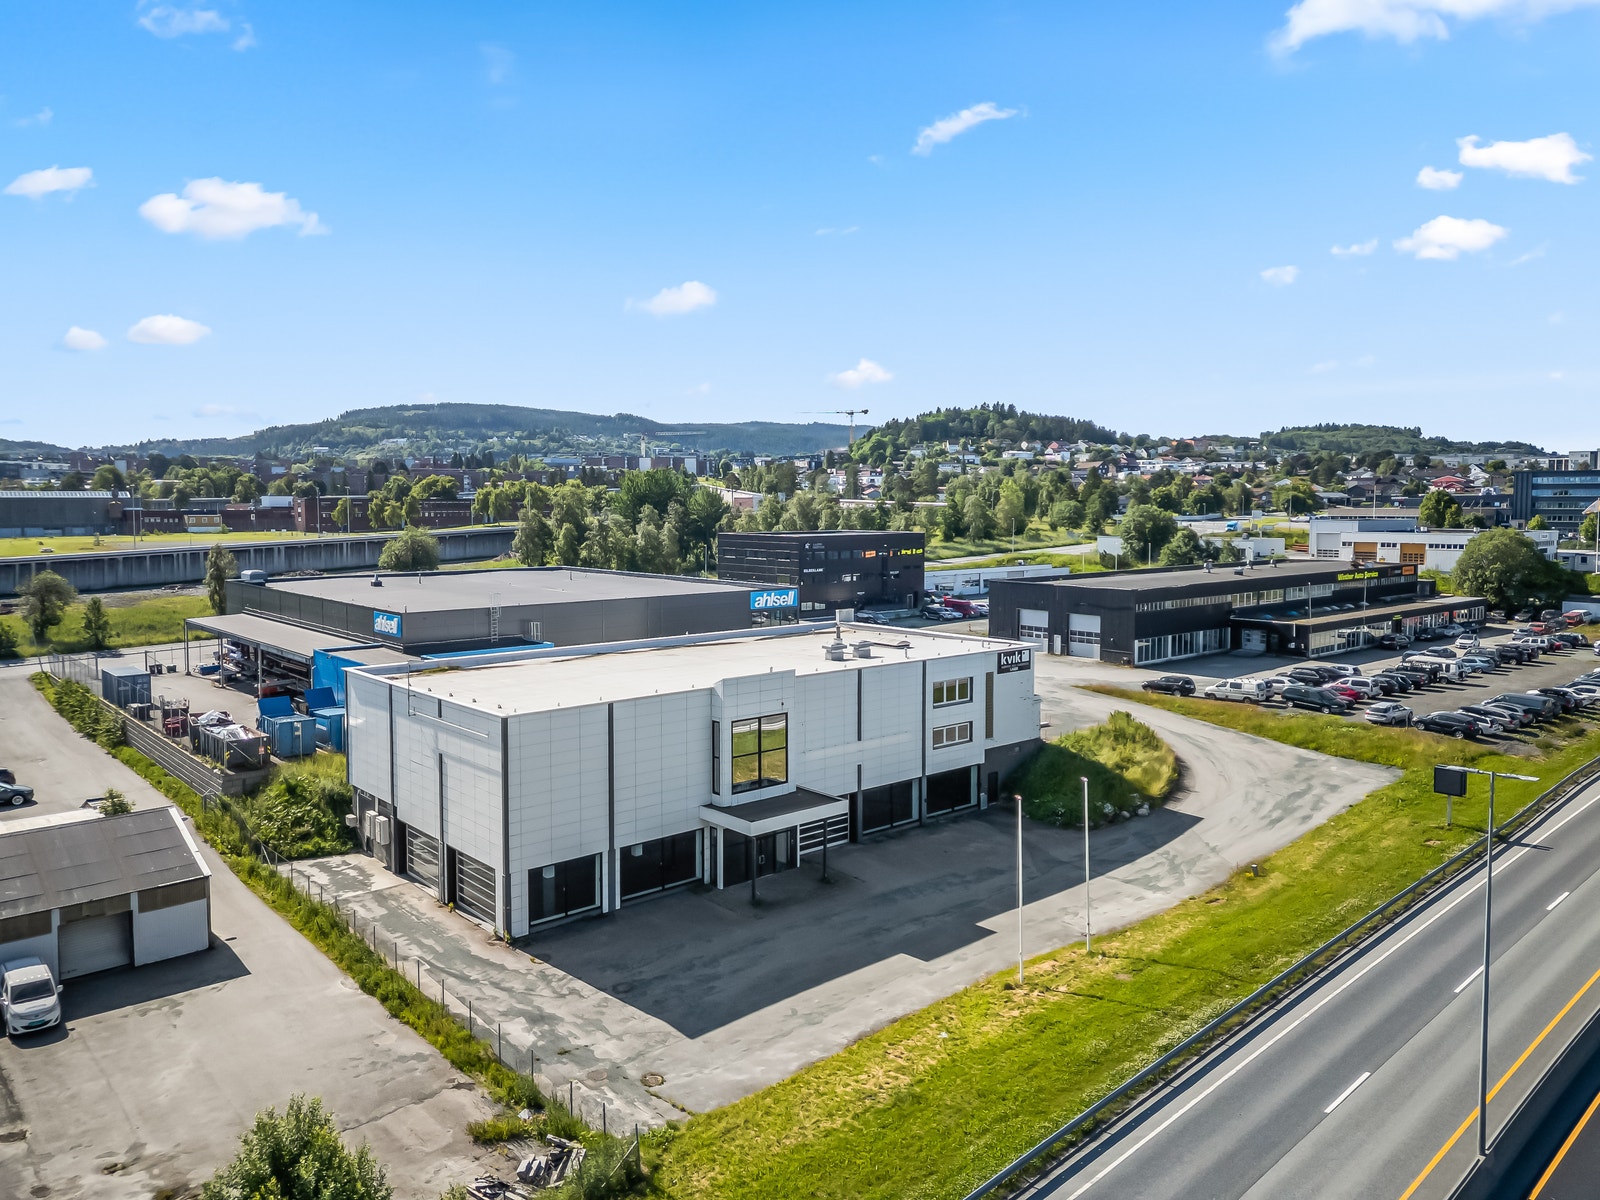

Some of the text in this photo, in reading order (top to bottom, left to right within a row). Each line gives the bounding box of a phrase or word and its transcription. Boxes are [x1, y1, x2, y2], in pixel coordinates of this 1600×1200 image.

[755, 591, 794, 608] ahlsell
[375, 614, 398, 634] ahlsell
[1001, 651, 1021, 665] kvik
